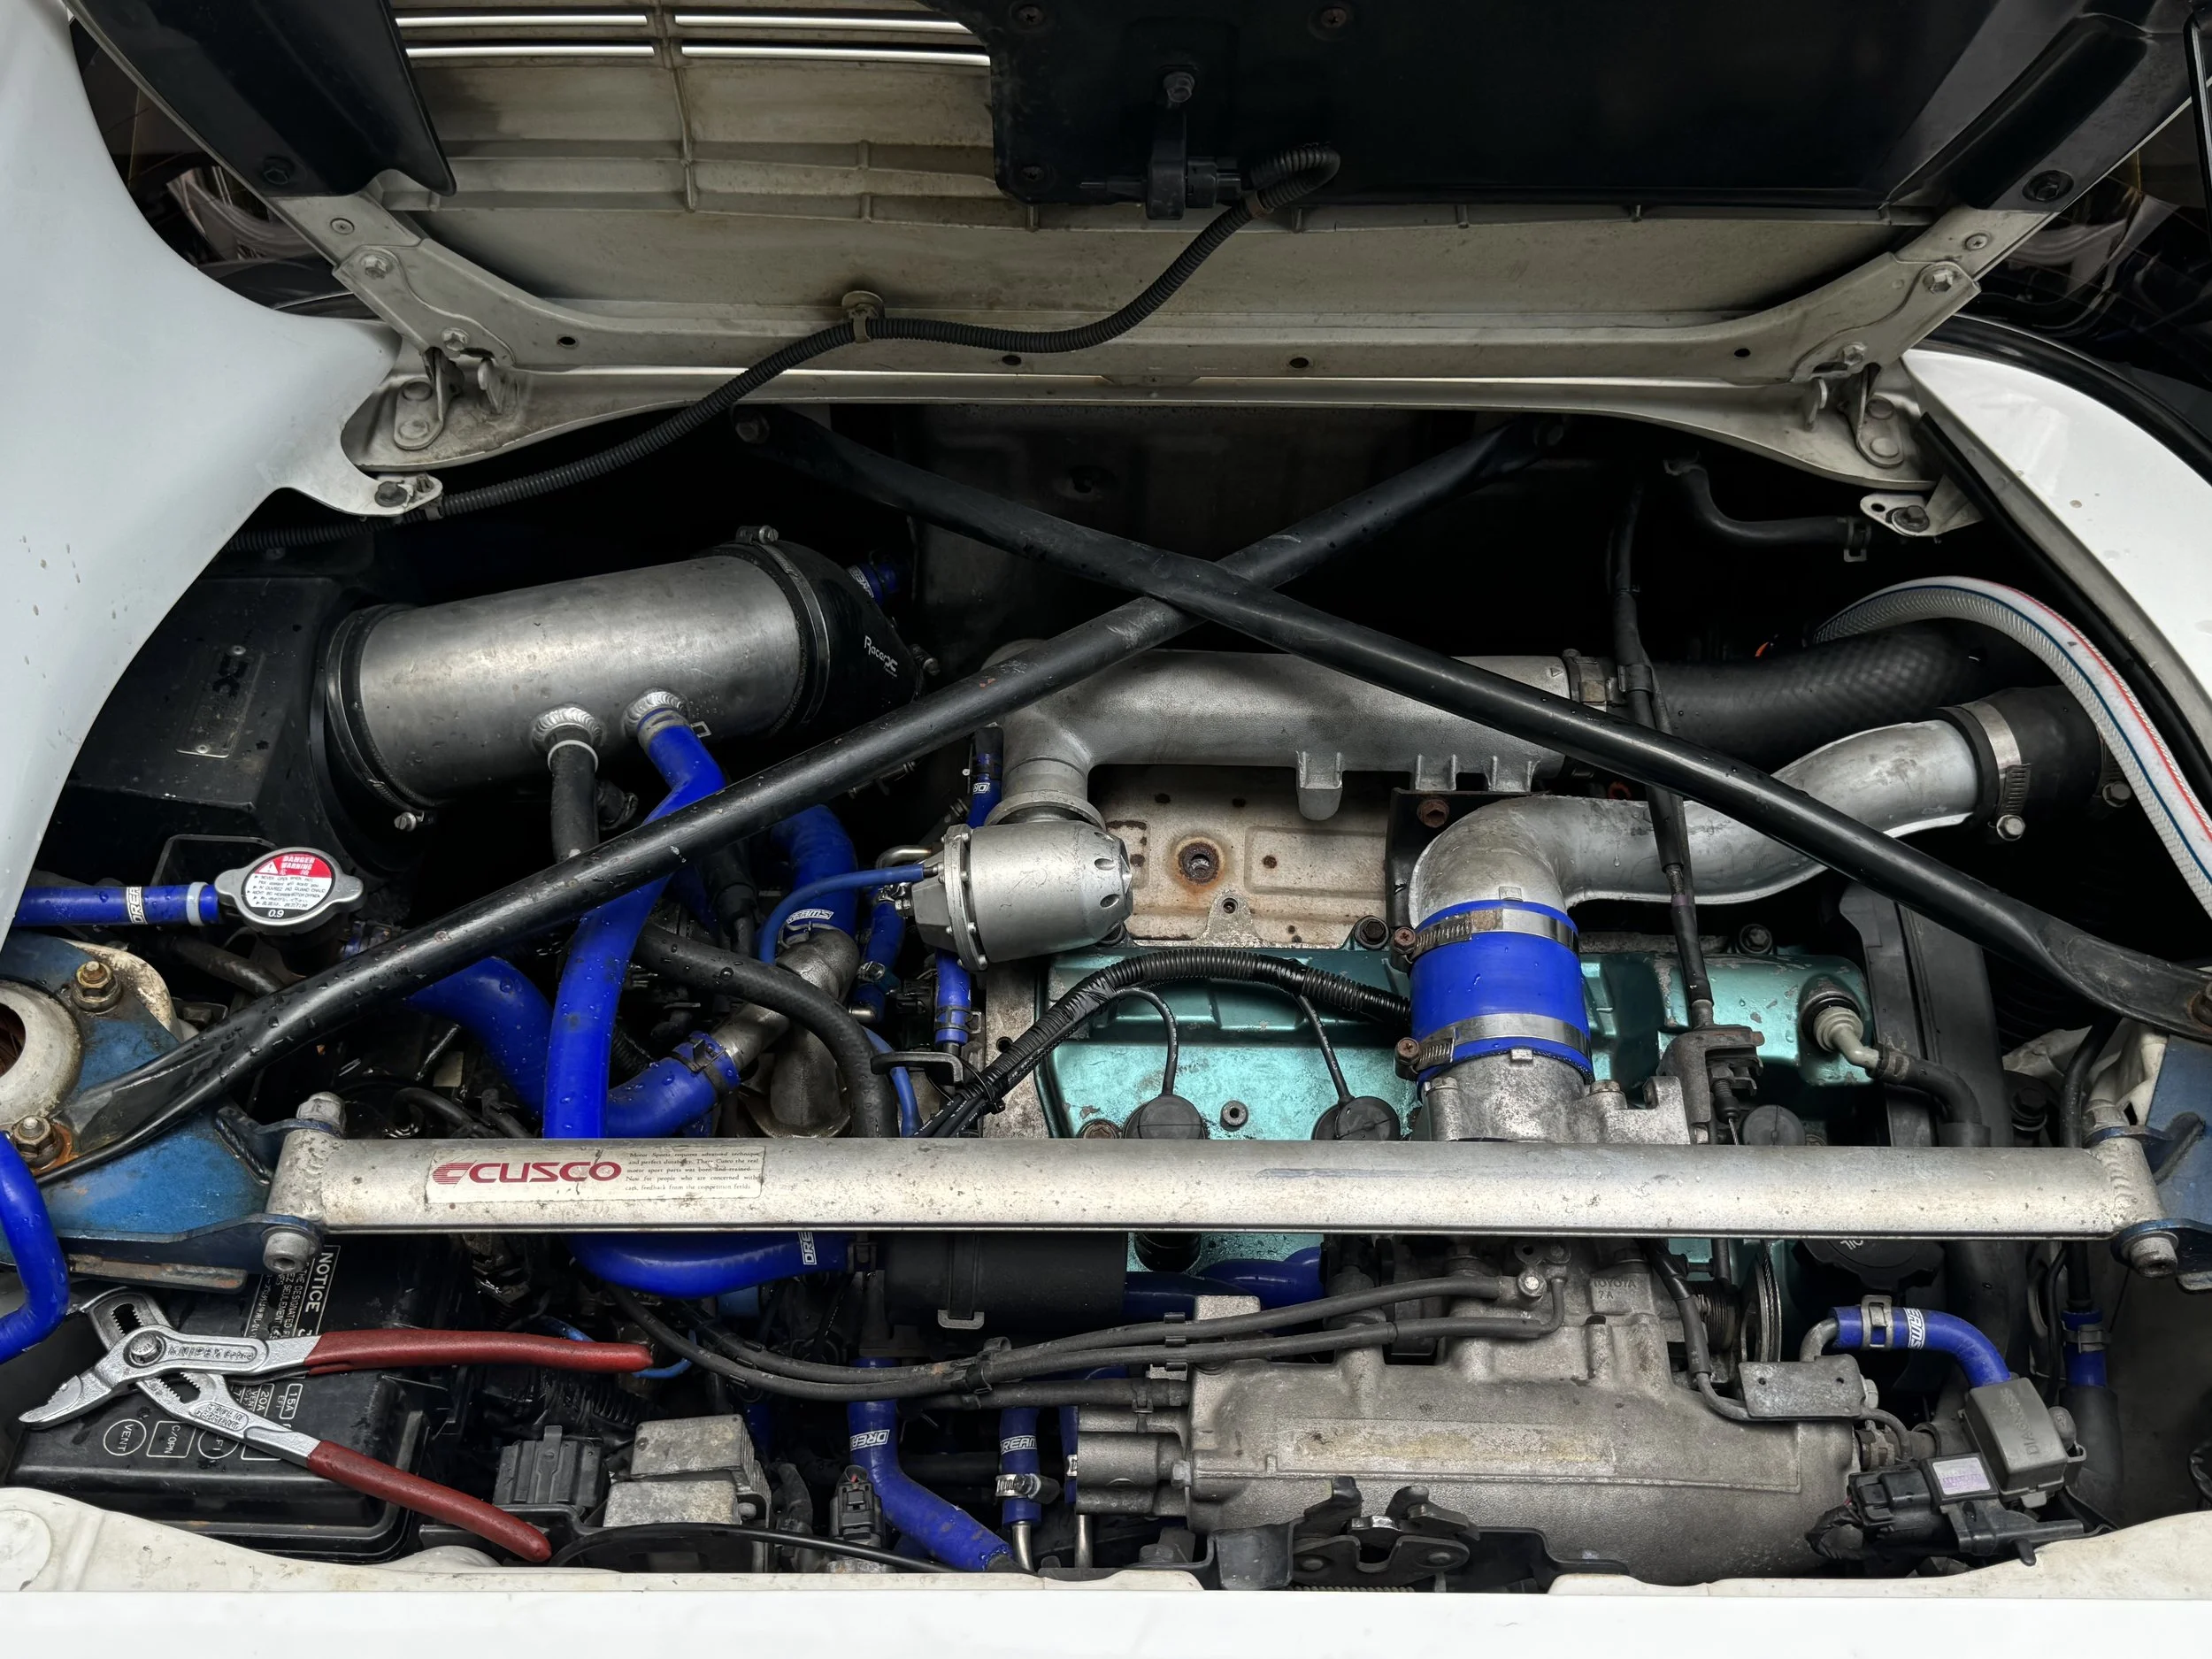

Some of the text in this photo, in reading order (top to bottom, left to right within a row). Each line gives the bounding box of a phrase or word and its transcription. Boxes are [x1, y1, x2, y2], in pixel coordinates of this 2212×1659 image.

[469, 1161, 622, 1184] CUSCO
[305, 1253, 334, 1312] NOTICE
[284, 1286, 303, 1328] DESIGNATED
[168, 1346, 222, 1357] KNIPEX
[206, 1402, 234, 1418] MADE
[257, 1391, 270, 1411] 20A
[284, 1391, 297, 1412] 15A
[195, 1409, 240, 1431] GERMANY
[118, 1424, 134, 1452] VENT
[165, 1425, 181, 1454] C/OPN
[212, 1435, 224, 1451] FI
